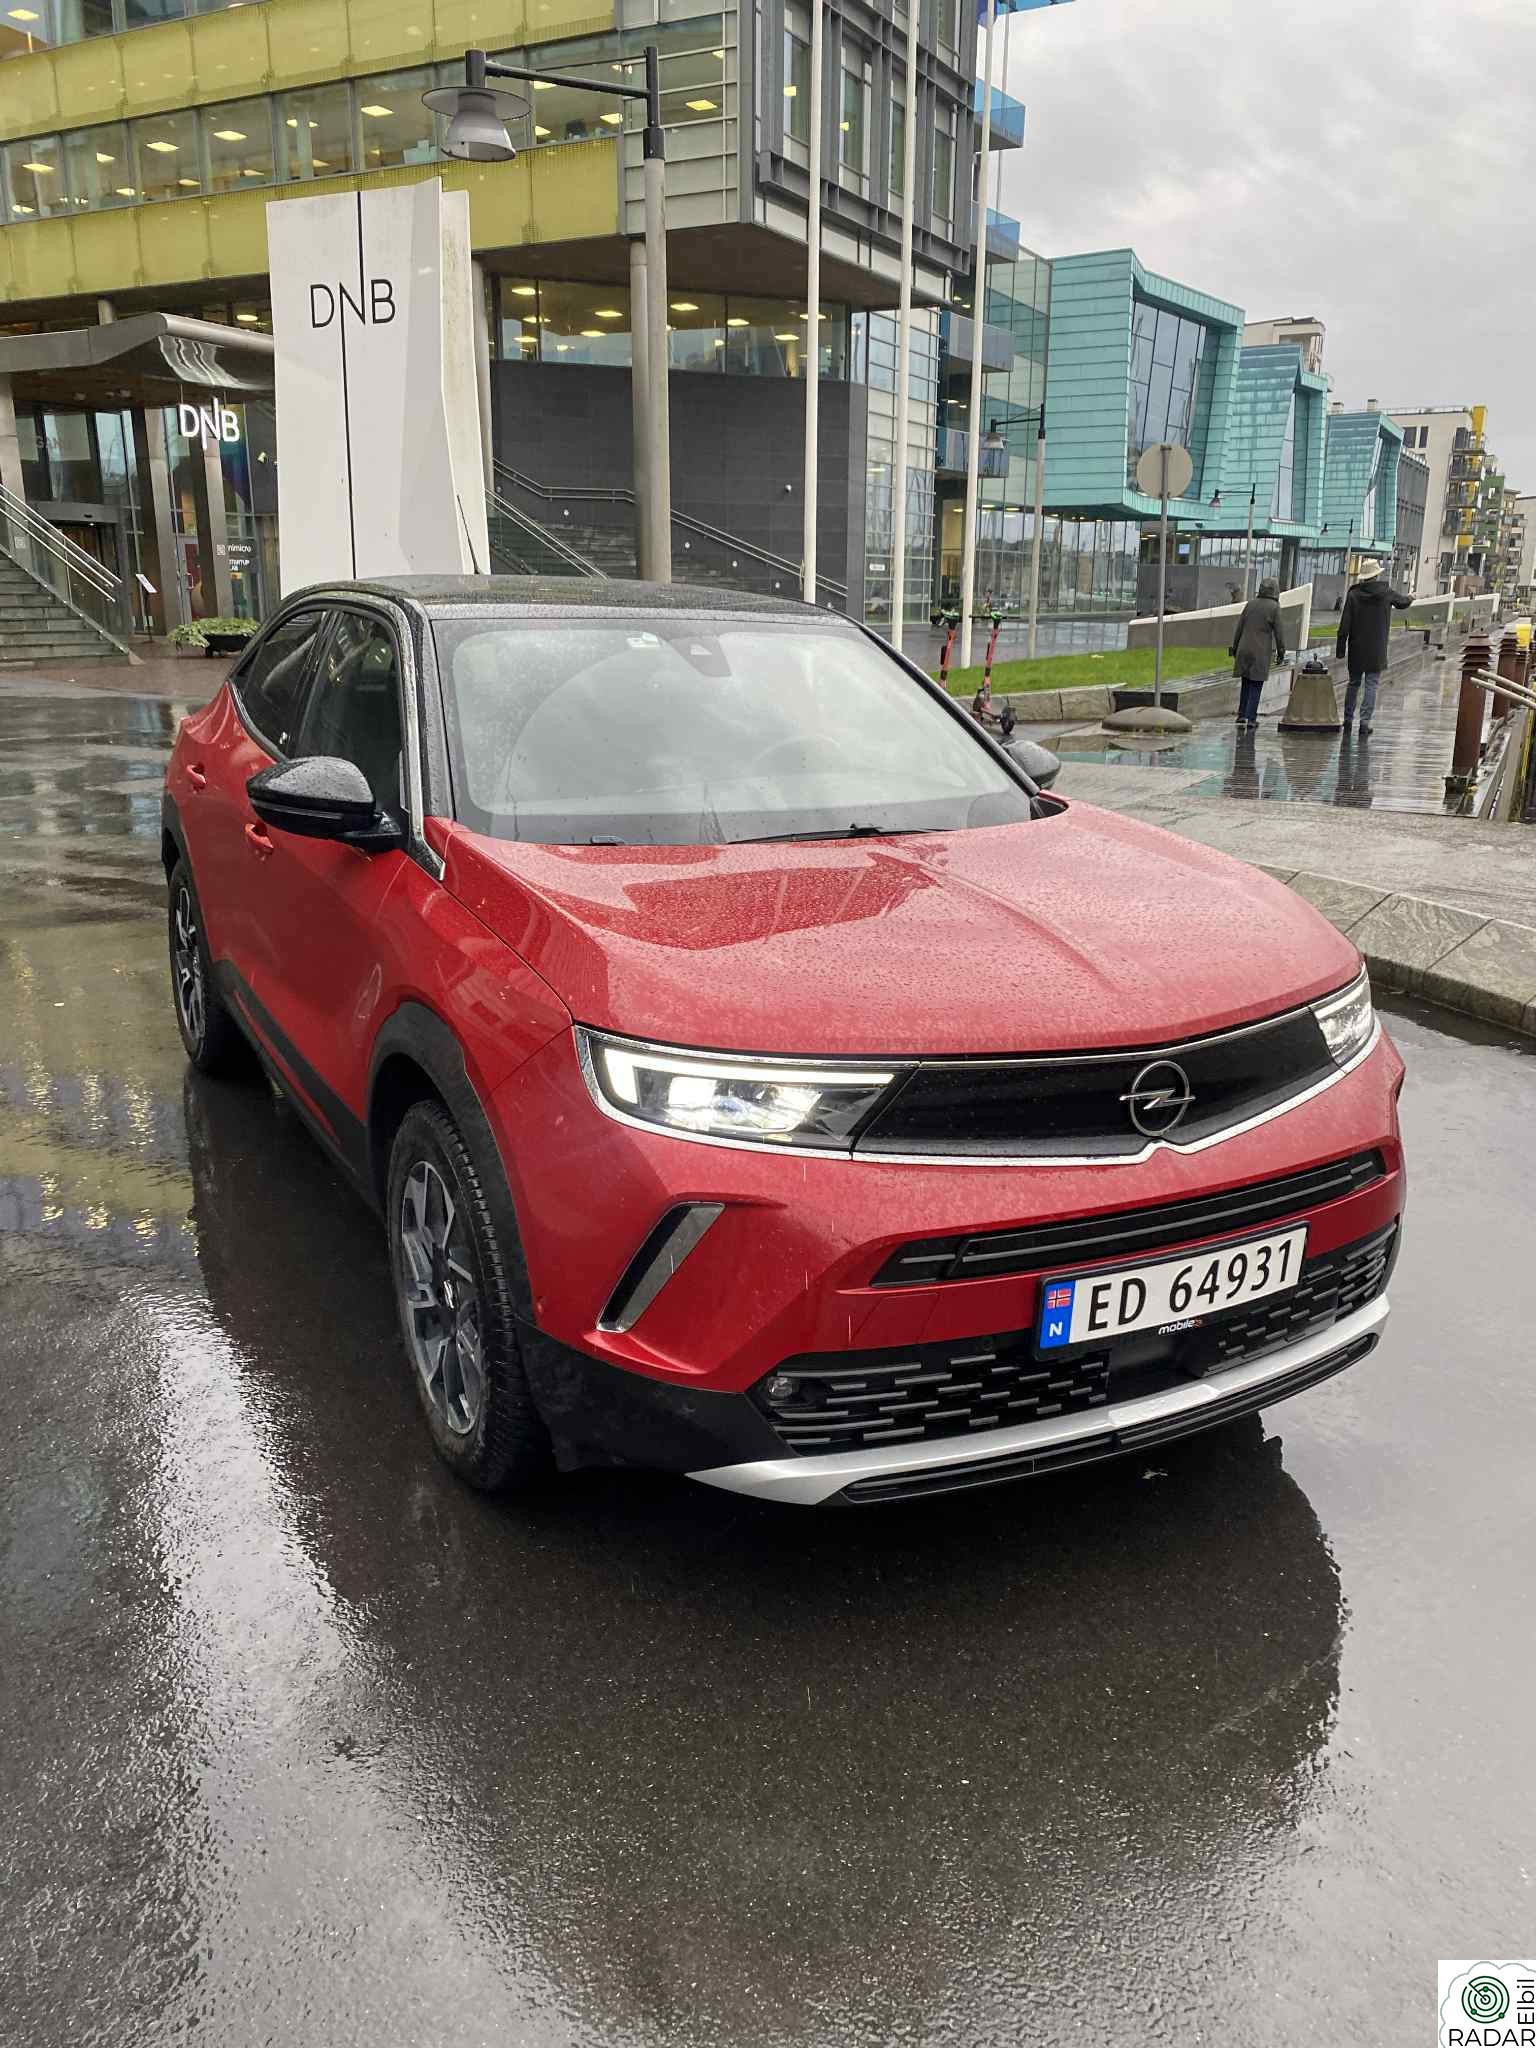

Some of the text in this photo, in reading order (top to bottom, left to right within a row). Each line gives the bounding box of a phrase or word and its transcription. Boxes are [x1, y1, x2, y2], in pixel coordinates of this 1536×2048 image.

[310, 278, 396, 328] DNB
[178, 397, 240, 451] DNB
[1087, 1239, 1292, 1332] ED 64931
[1049, 1321, 1063, 1337] N
